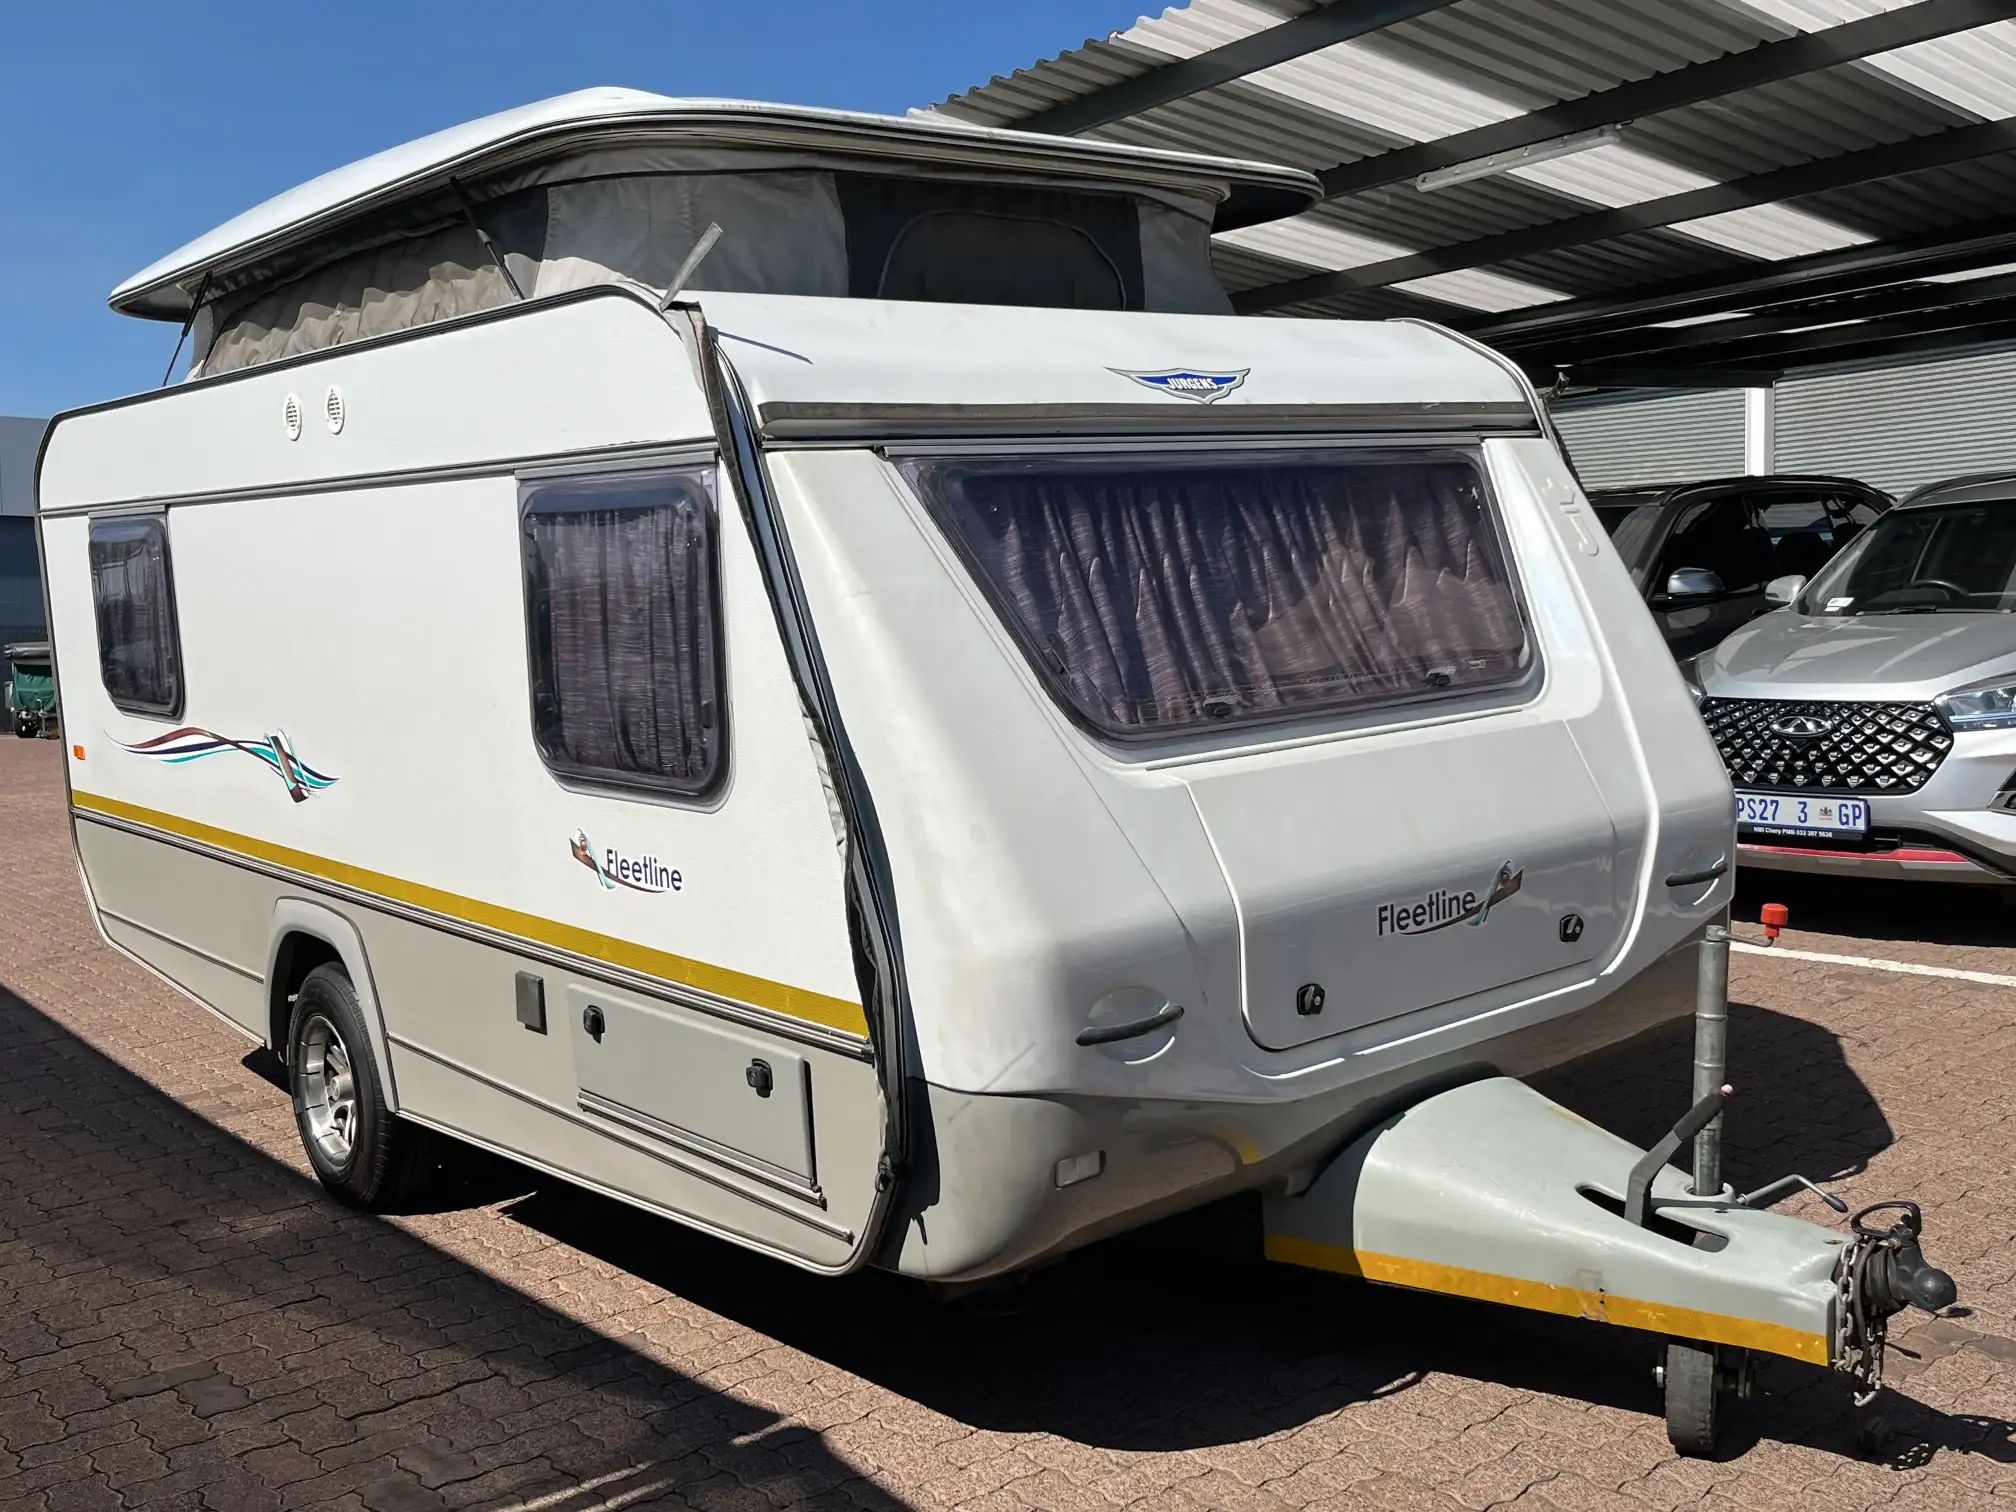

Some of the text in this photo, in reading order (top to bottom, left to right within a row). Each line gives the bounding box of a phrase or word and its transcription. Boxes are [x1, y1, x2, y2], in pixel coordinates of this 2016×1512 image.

[1166, 377, 1219, 390] JURGENS
[1838, 803, 1863, 827] GP
[1766, 827, 1781, 835] Chery
[606, 848, 682, 891] Fleetline
[1377, 890, 1476, 936] Fleetline
